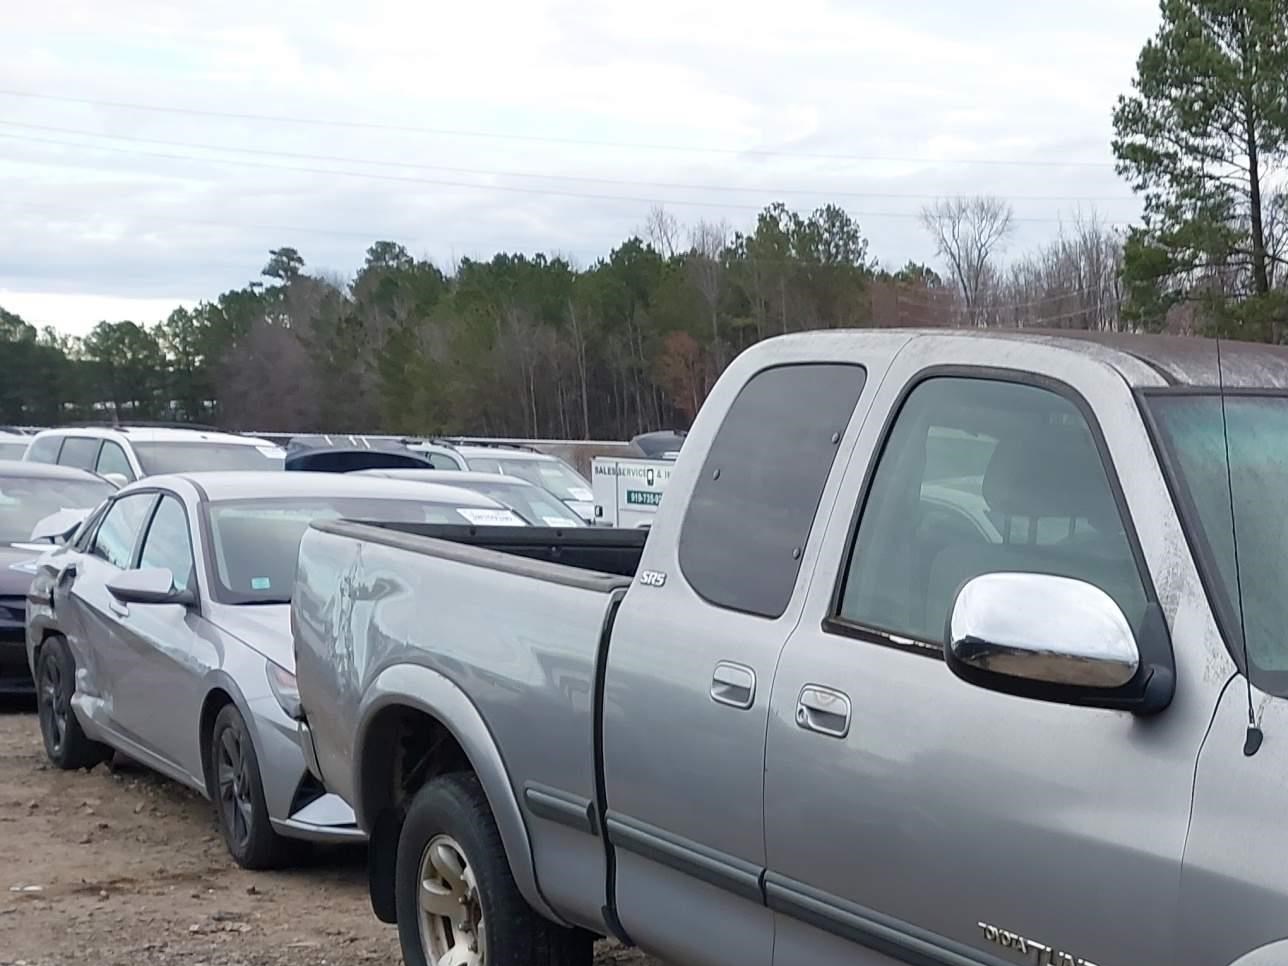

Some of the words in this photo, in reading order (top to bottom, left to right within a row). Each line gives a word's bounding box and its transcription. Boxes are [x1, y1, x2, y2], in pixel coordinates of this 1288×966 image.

[594, 465, 617, 476] SALES
[640, 570, 667, 587] SR5
[978, 921, 1027, 953] TOYOTA
